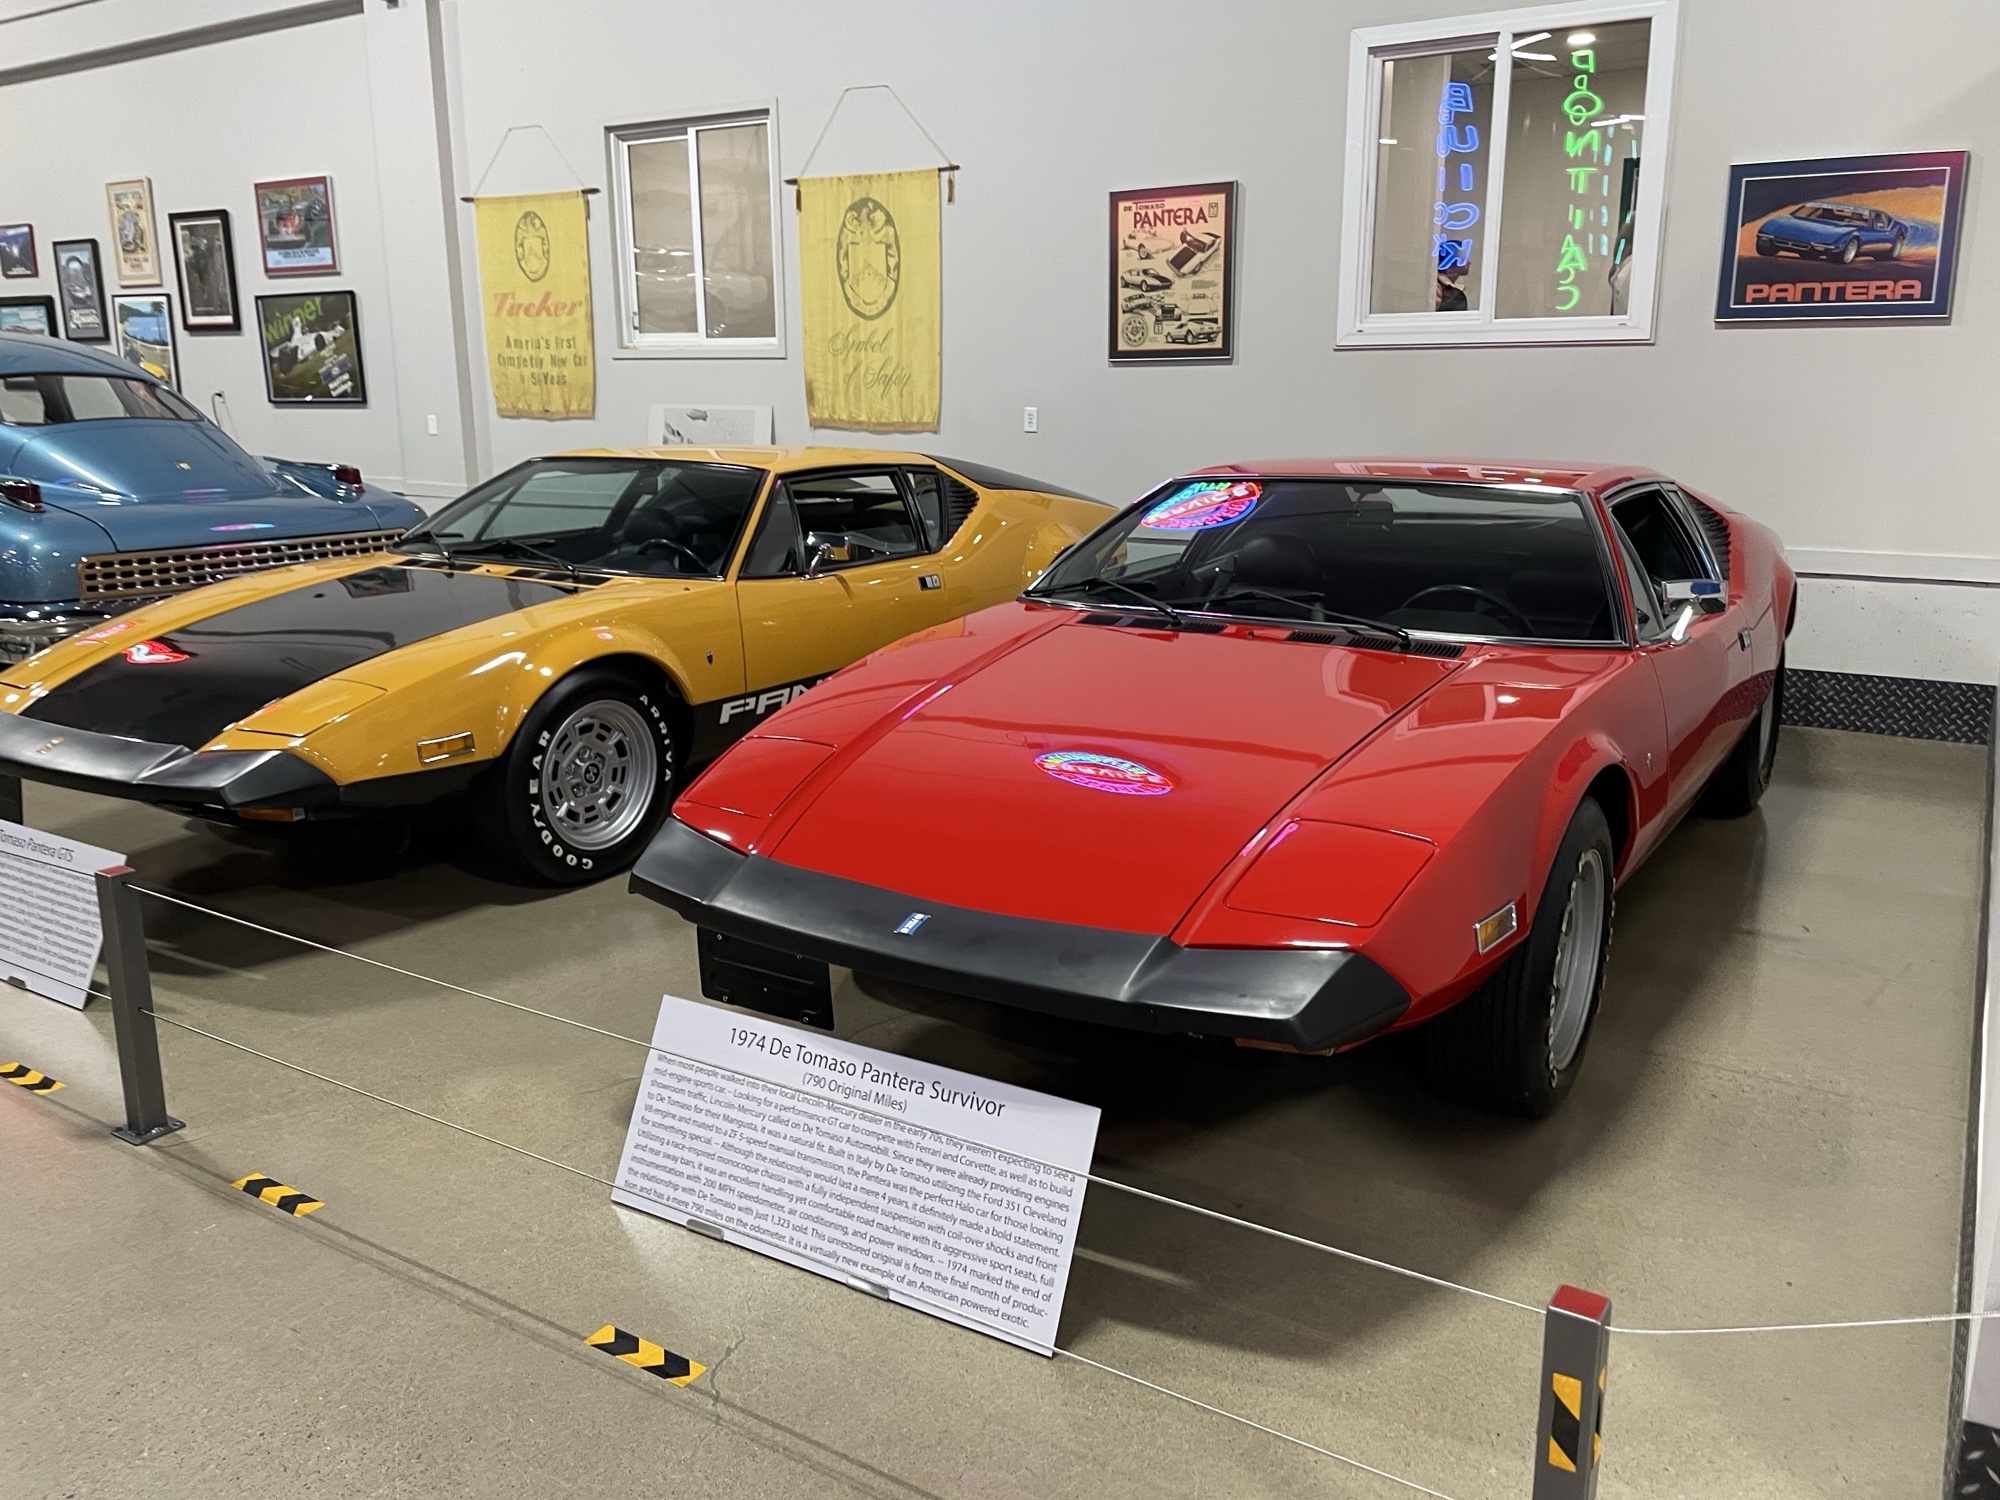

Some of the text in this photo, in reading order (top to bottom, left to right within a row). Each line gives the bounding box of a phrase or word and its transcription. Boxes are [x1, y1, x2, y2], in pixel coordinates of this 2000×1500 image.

[1133, 207, 1209, 228] PANTERA
[493, 291, 583, 318] Tucker
[1745, 279, 1922, 303] PANTERA
[639, 694, 673, 782] ARRIVA
[529, 730, 594, 870] GOODYEAR
[27, 837, 56, 857] Pantera
[57, 846, 76, 863] GTS
[730, 1027, 1005, 1117] 1974 De Tomaso Pantera Survivor
[802, 1071, 907, 1113] (790 Original Miles)
[778, 1103, 1073, 1197] performance GT car compete with Ferrari and Corvette, as well as to build
[802, 1122, 1070, 1212] De Tomaso Since they were already providing engines
[827, 1144, 846, 1158] Built
[855, 1153, 873, 1168] Italy
[885, 1162, 898, 1175] De
[899, 1166, 930, 1184] Tomaso
[931, 1179, 966, 1198] utilizing
[966, 1188, 982, 1201] the
[982, 1192, 1003, 1207] Ford
[1004, 1199, 1020, 1212] 351
[1022, 1205, 1067, 1227] Cleveland
[892, 1120, 907, 1133] the
[906, 1127, 928, 1140] early
[945, 1136, 964, 1151] they
[965, 1144, 997, 1159] werent
[997, 1153, 1041, 1174] expecting
[1042, 1165, 1052, 1175] to
[1053, 1169, 1069, 1181] see
[760, 1182, 1055, 1288] handling yet comfortable road machine with its aggressive sport seats, full
[767, 1157, 1060, 1258] relationship would last mere 4 years, definitely made bold statement.
[828, 1189, 1057, 1273] independent suspension with coil-over shocks and front
[846, 1166, 860, 1178] the
[860, 1169, 891, 1187] Pantera
[892, 1181, 908, 1193] was
[908, 1185, 923, 1198] the
[923, 1191, 954, 1207] perfect
[954, 1199, 975, 1214] Halo
[975, 1208, 989, 1218] car
[989, 1209, 1003, 1222] for
[1003, 1215, 1028, 1231] those
[1029, 1222, 1064, 1244] looking
[748, 1223, 787, 1243] odometer.
[841, 1255, 859, 1267] new
[860, 1262, 895, 1281] example
[896, 1274, 907, 1284] of
[905, 1278, 917, 1288] an
[918, 1280, 959, 1303] American
[959, 1297, 1000, 1317] powered
[1000, 1311, 1029, 1328] exotic.
[770, 1214, 791, 1229] 1,323
[791, 1223, 809, 1236] sold.
[810, 1227, 826, 1241] This
[826, 1235, 871, 1256] unrestored
[871, 1251, 903, 1267] original
[912, 1262, 932, 1278] from
[933, 1271, 948, 1284] the
[949, 1275, 969, 1290] final
[970, 1284, 1000, 1301] month
[1001, 1294, 1012, 1305] of
[1011, 1299, 1048, 1317] produc-
[798, 1211, 849, 1236] conditioning,
[851, 1228, 868, 1240] and
[868, 1234, 895, 1249] power
[896, 1244, 935, 1264] windows.
[947, 1259, 967, 1274] 1974
[969, 1268, 1003, 1286] marked
[1004, 1279, 1020, 1292] the
[1021, 1286, 1040, 1299] end
[1041, 1292, 1053, 1302] of
